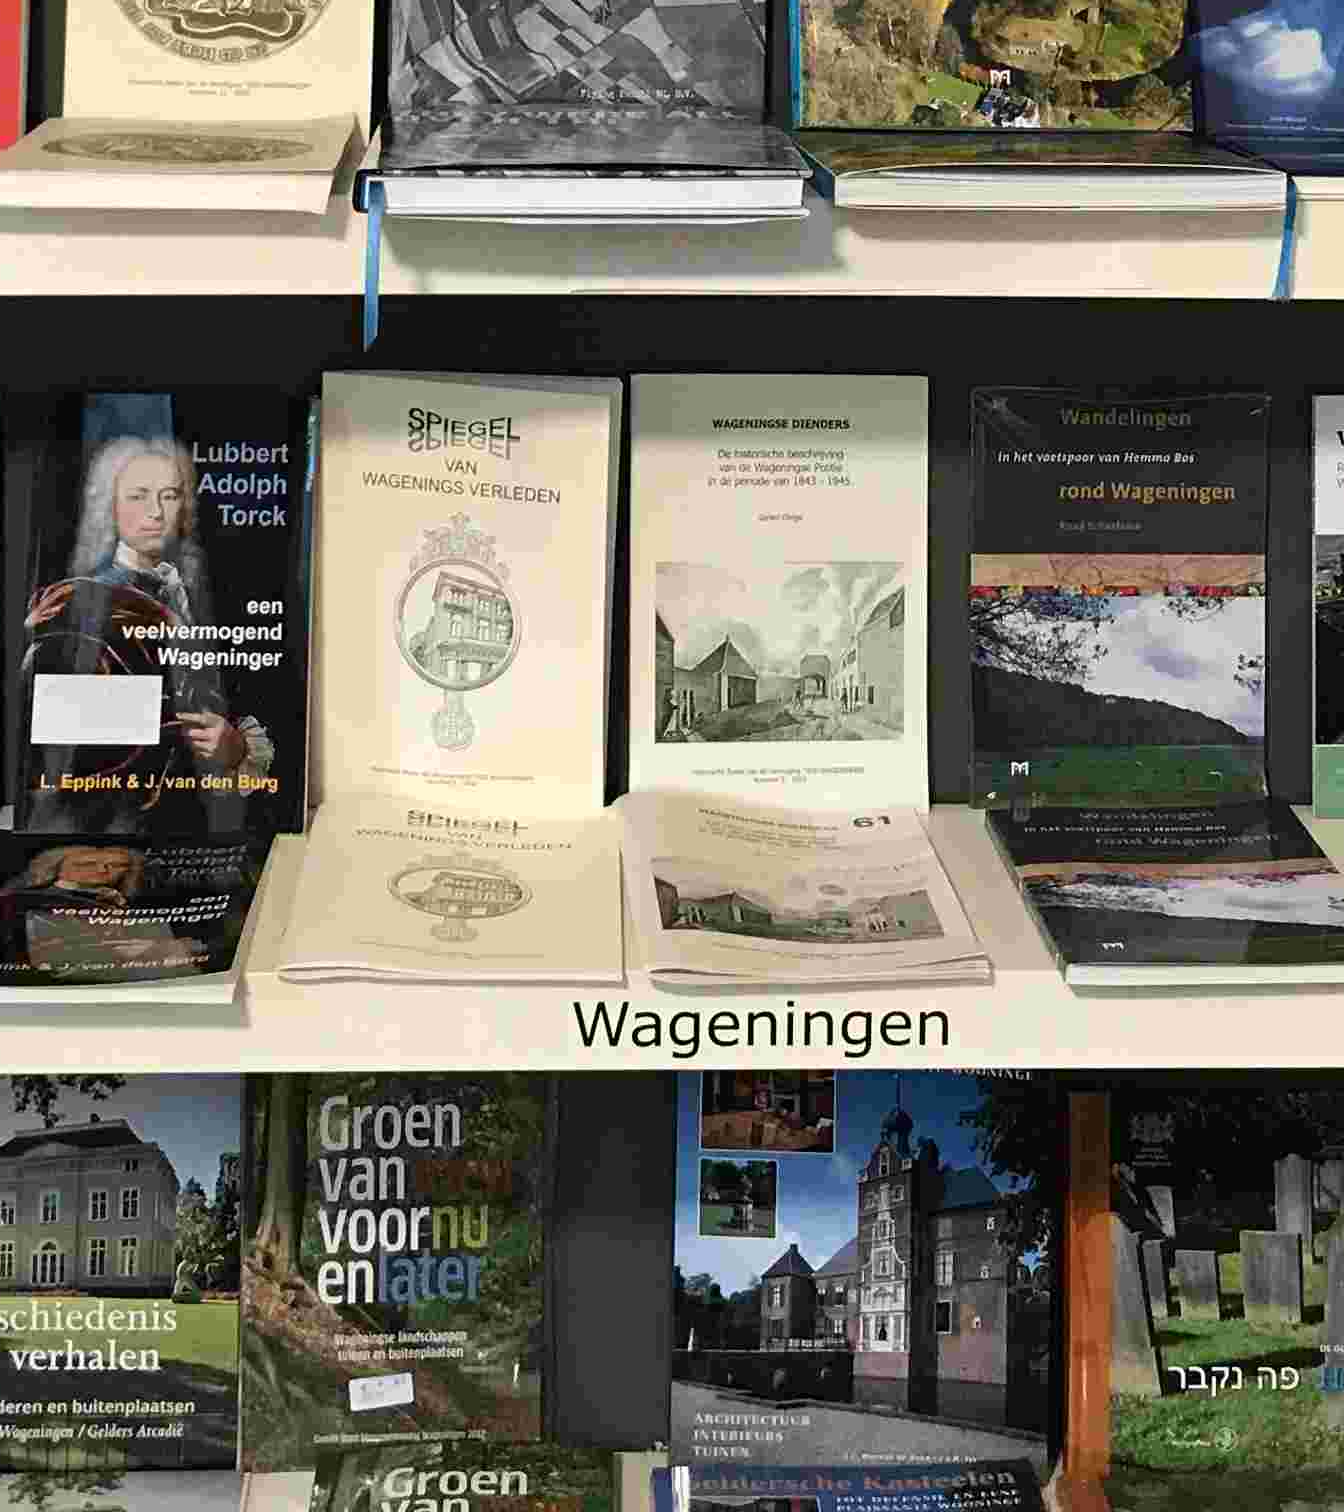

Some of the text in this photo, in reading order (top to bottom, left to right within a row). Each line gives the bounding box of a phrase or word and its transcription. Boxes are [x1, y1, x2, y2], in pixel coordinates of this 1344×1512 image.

[712, 418, 850, 430] WAGENINGSE DIENDERS
[193, 441, 289, 464] Lubbert
[198, 473, 288, 498] Adolph
[218, 504, 287, 527] Torck
[247, 601, 283, 615] een
[123, 622, 282, 644] veelvermogend
[158, 649, 282, 671] Wageninger
[574, 1001, 949, 1058] Wageningen
[319, 1095, 463, 1151] Groen
[319, 1155, 405, 1202] van
[9, 1339, 160, 1371] verhalen
[46, 1400, 66, 1414] en
[72, 1399, 195, 1416] buitenplaatsen
